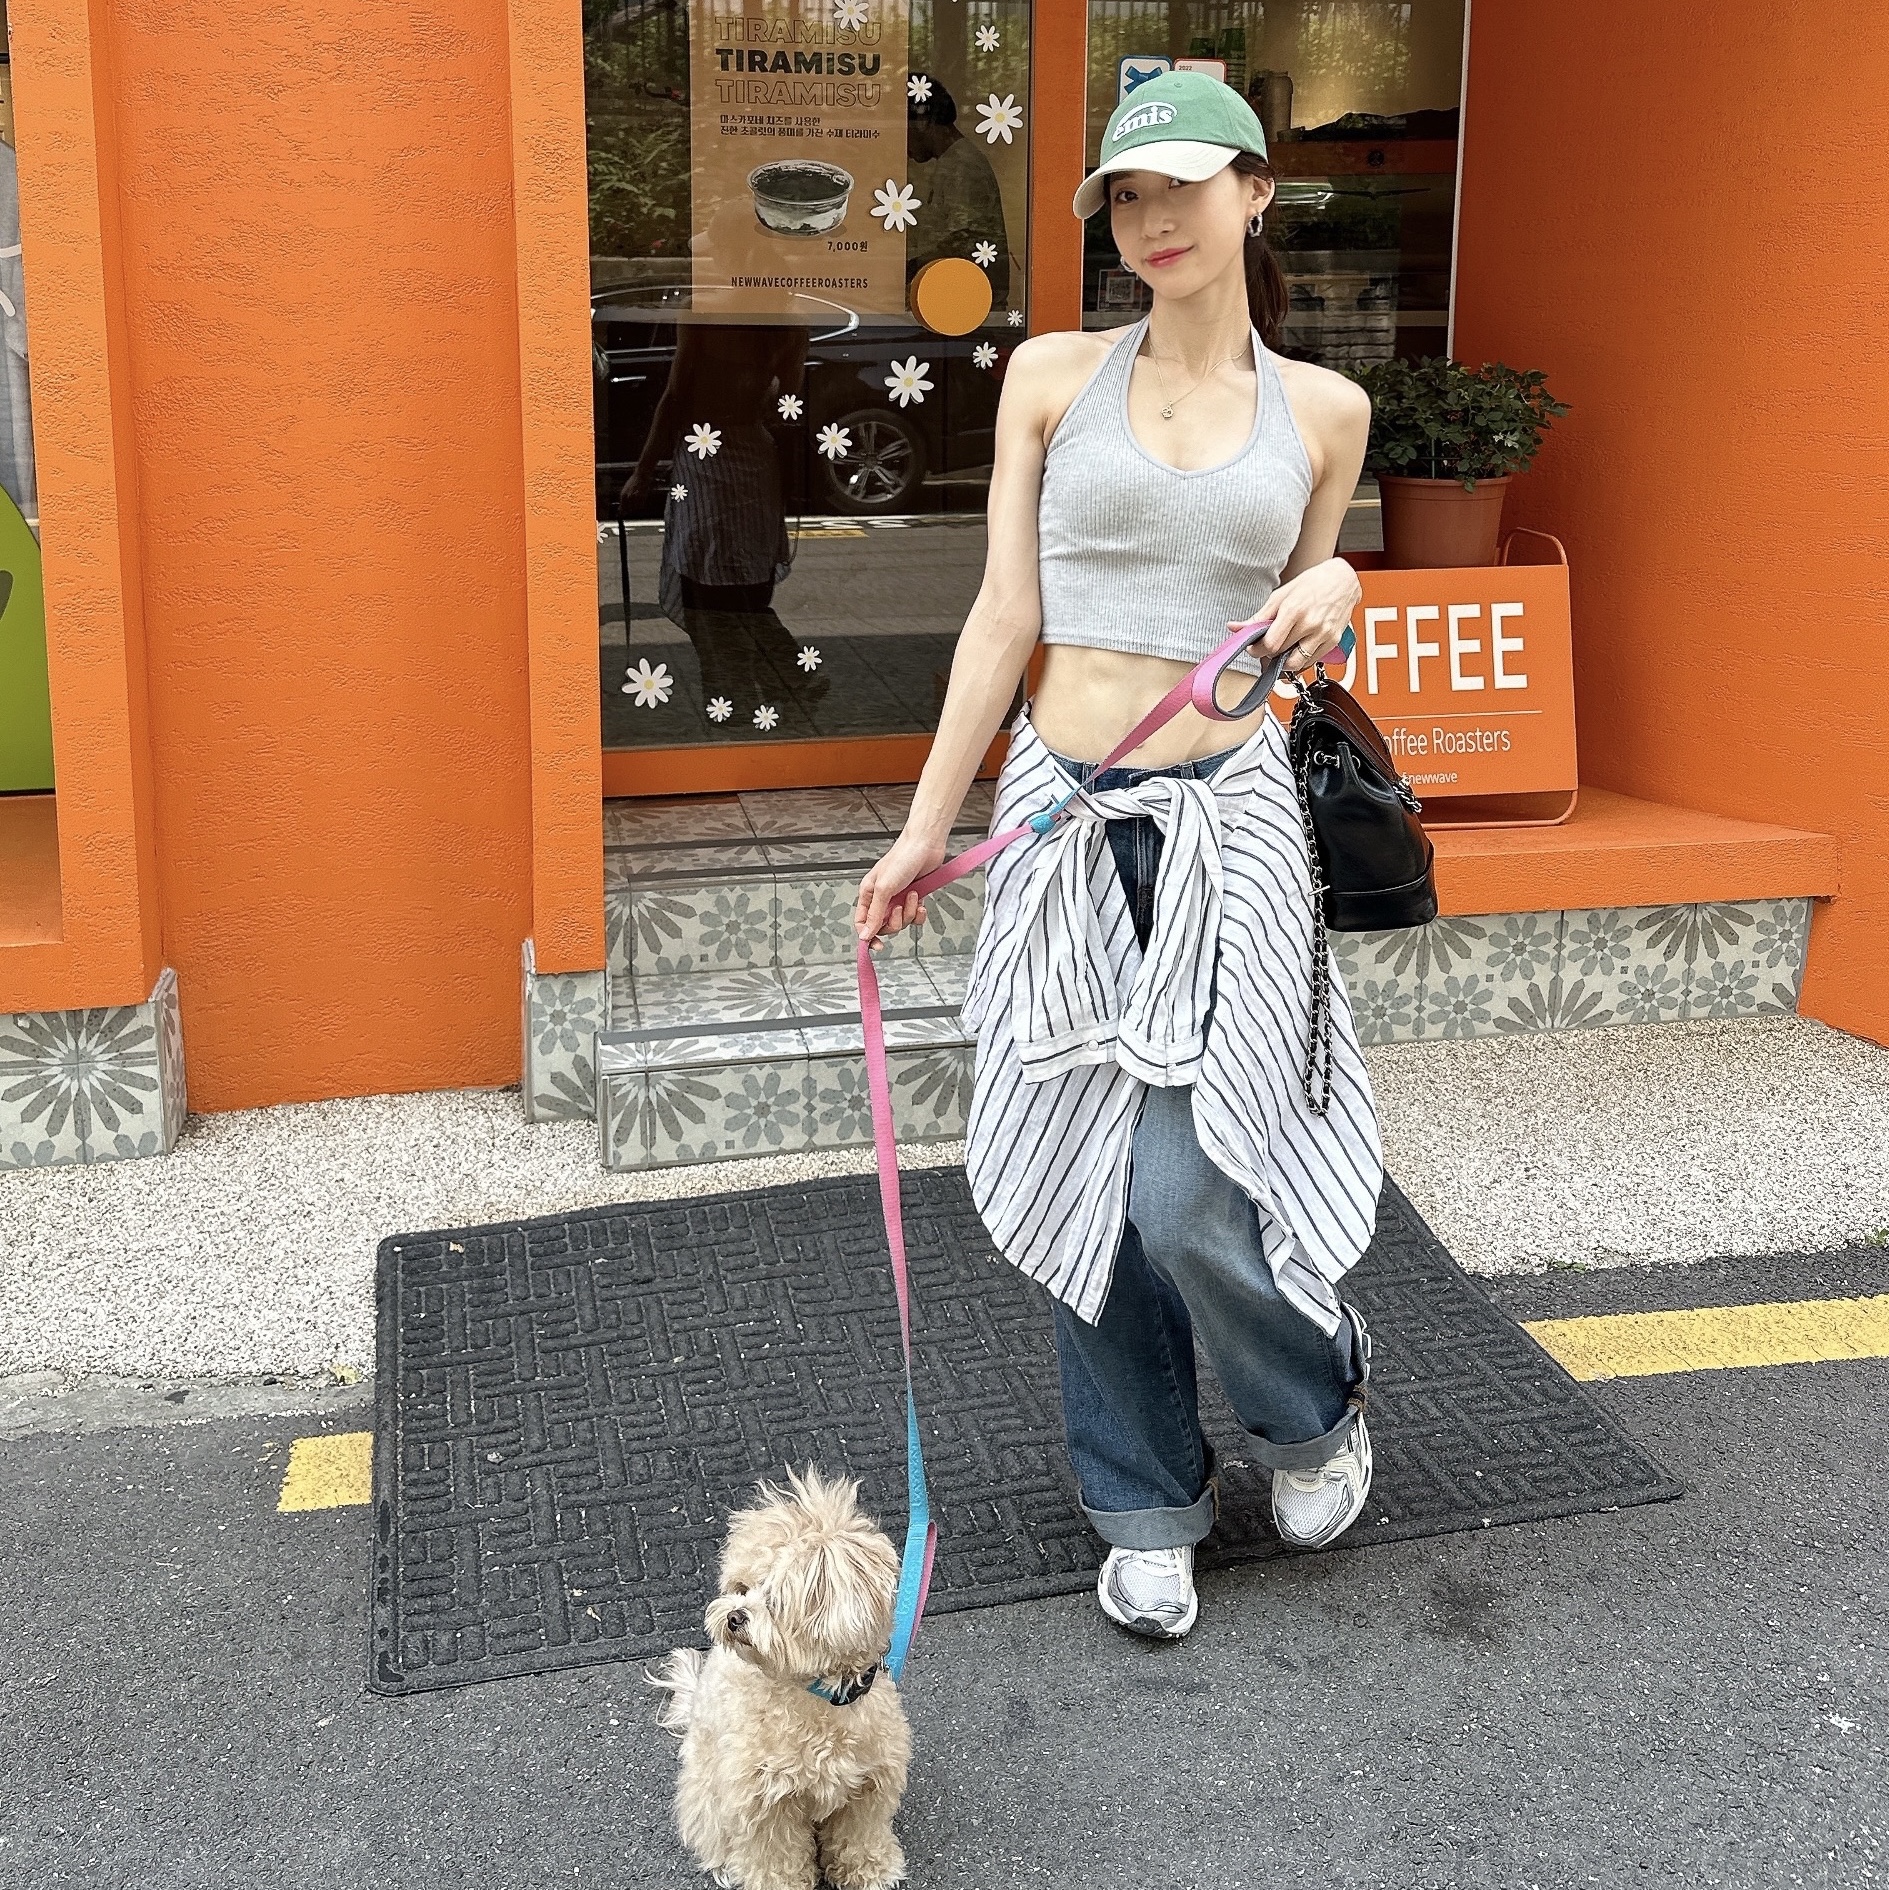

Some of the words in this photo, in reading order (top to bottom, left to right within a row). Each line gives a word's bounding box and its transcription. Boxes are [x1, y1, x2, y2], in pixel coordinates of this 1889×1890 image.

[715, 17, 881, 46] TIRAMISU
[715, 79, 881, 107] TIRAMISU
[720, 125, 739, 136] 진한
[805, 127, 824, 138] 가진
[845, 128, 880, 139] 티라미수
[794, 116, 821, 127] 사용한
[1112, 104, 1175, 141] emis
[827, 240, 868, 253] 7,000원
[730, 276, 869, 289] NEWWAVECOFFEEROASTERS
[1383, 727, 1428, 756] offee
[1432, 727, 1511, 754] Roasters
